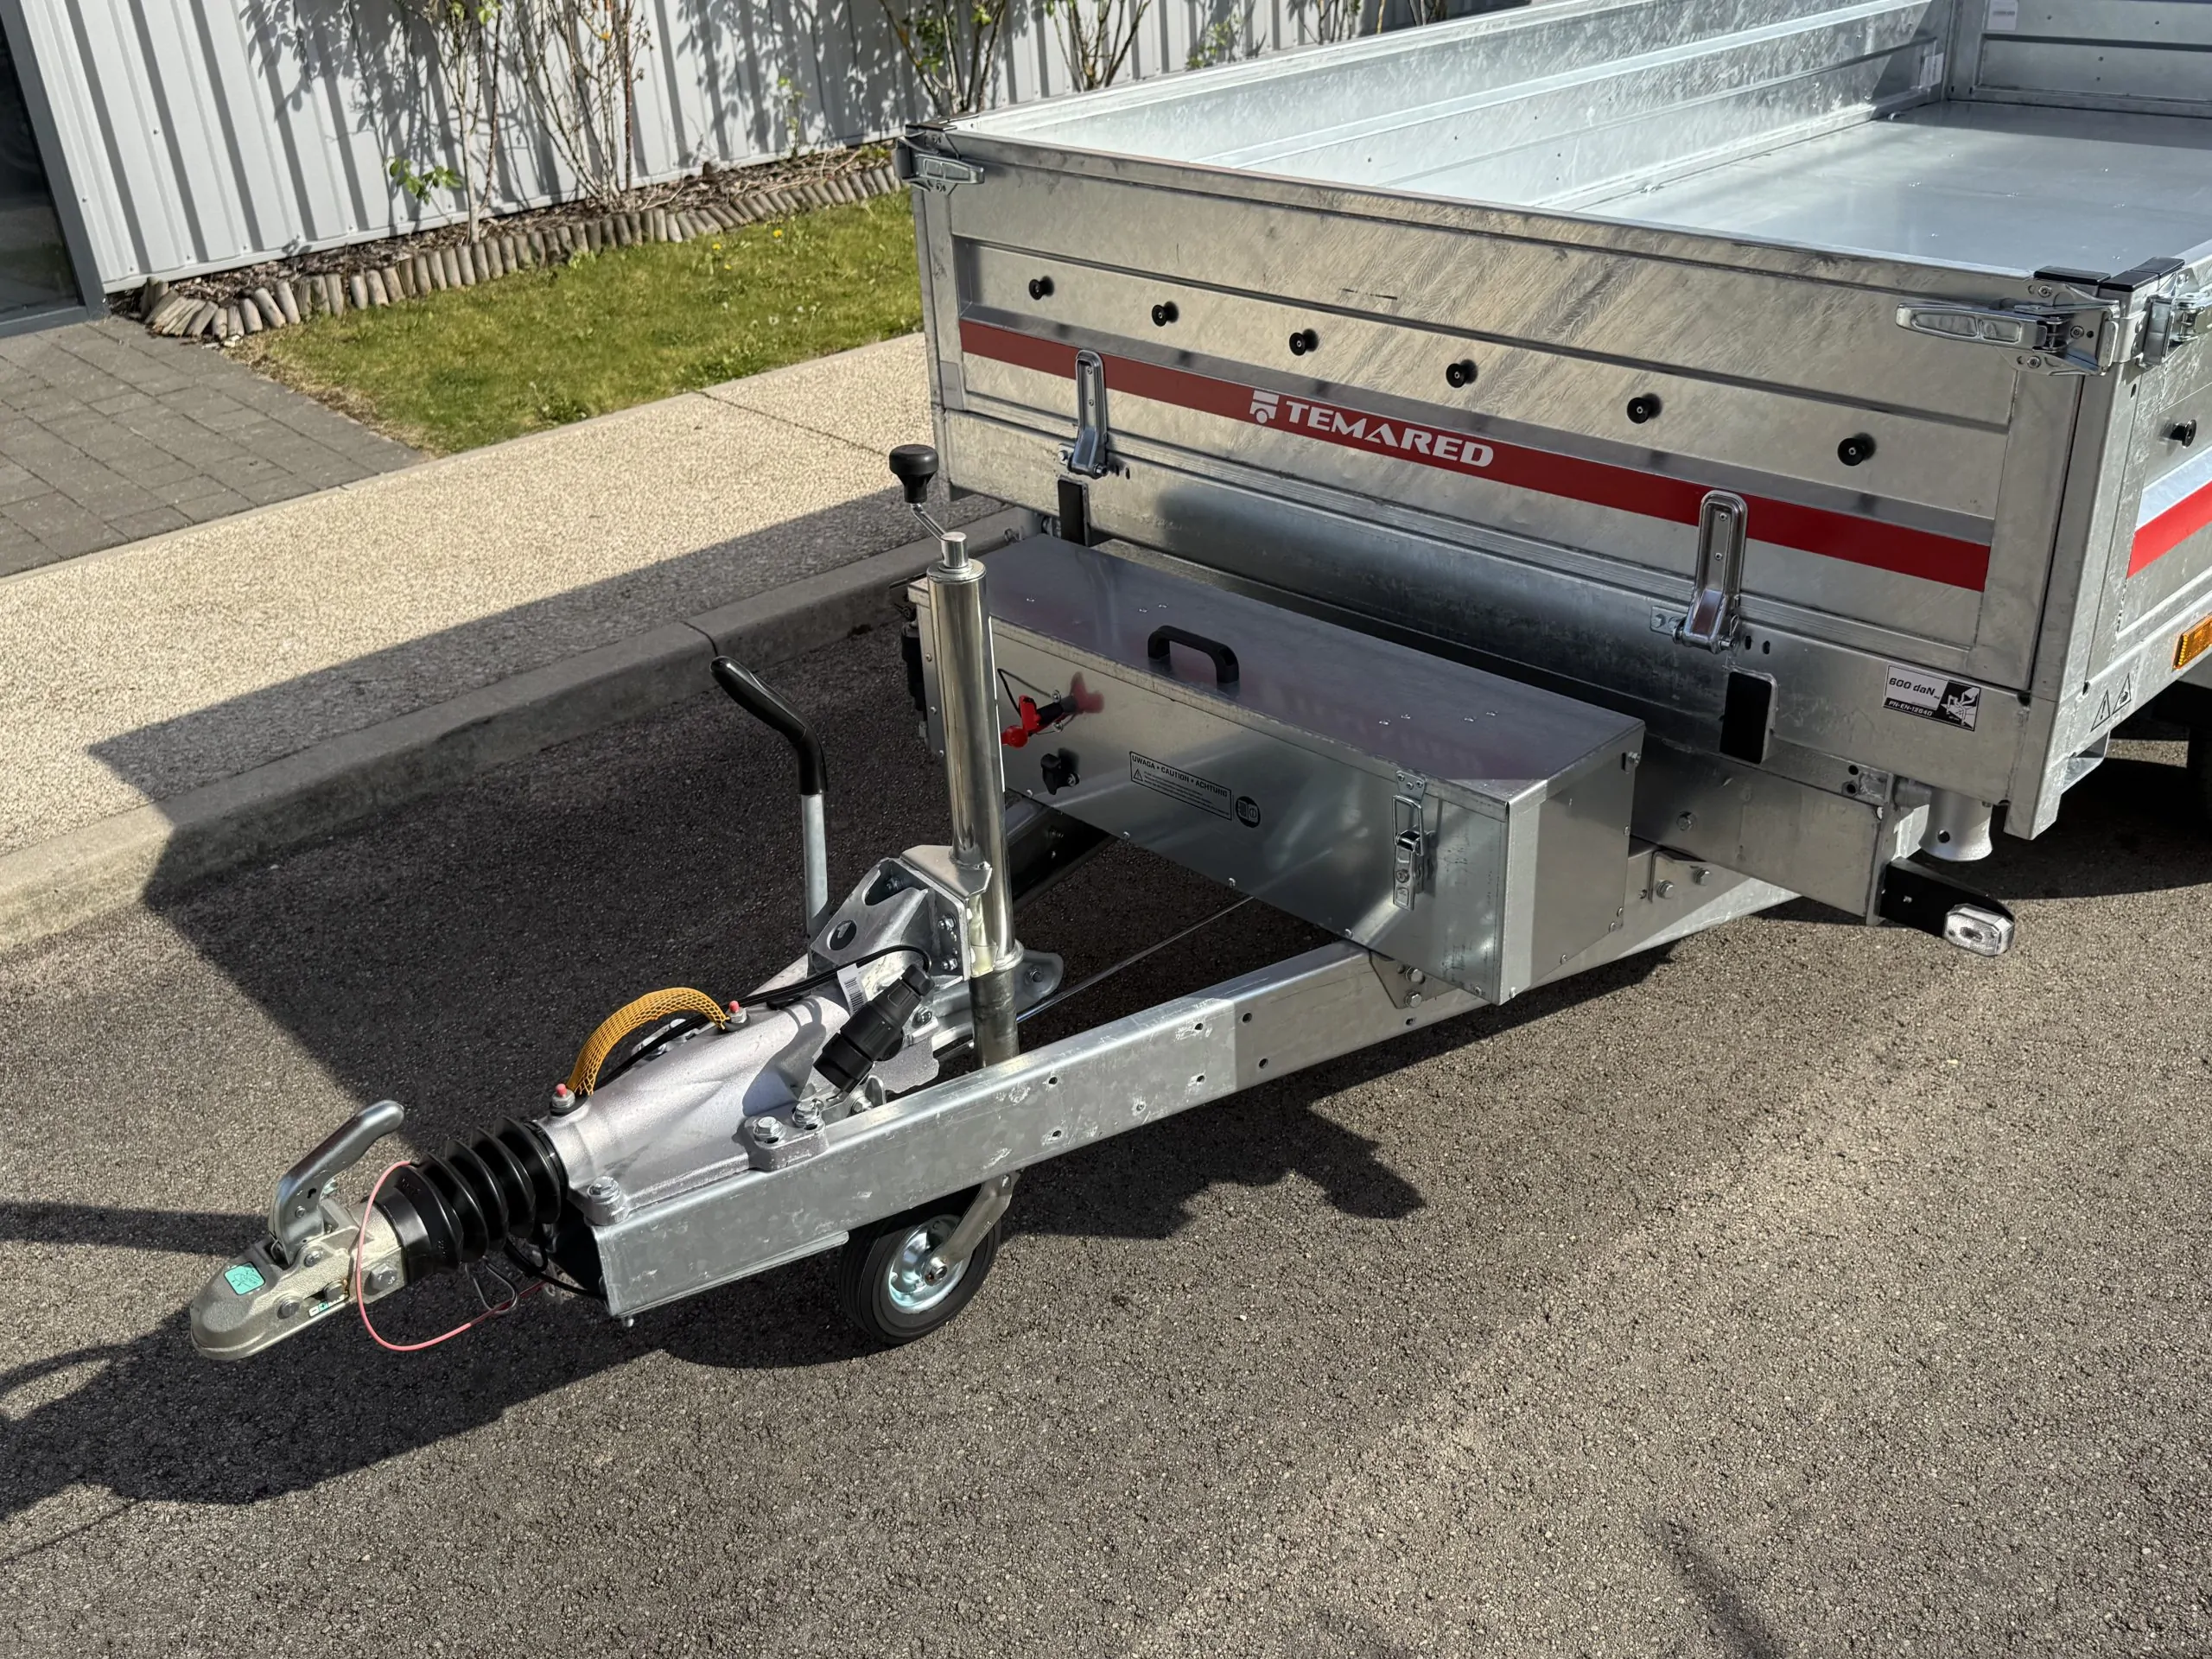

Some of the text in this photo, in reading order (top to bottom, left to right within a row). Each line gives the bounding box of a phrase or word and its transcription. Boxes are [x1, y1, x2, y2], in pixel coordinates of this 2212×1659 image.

[1286, 400, 1494, 467] TEMARED
[1913, 683, 1936, 696] daN
[1132, 754, 1228, 798] UWAGA CAUTION ACHTUNG
